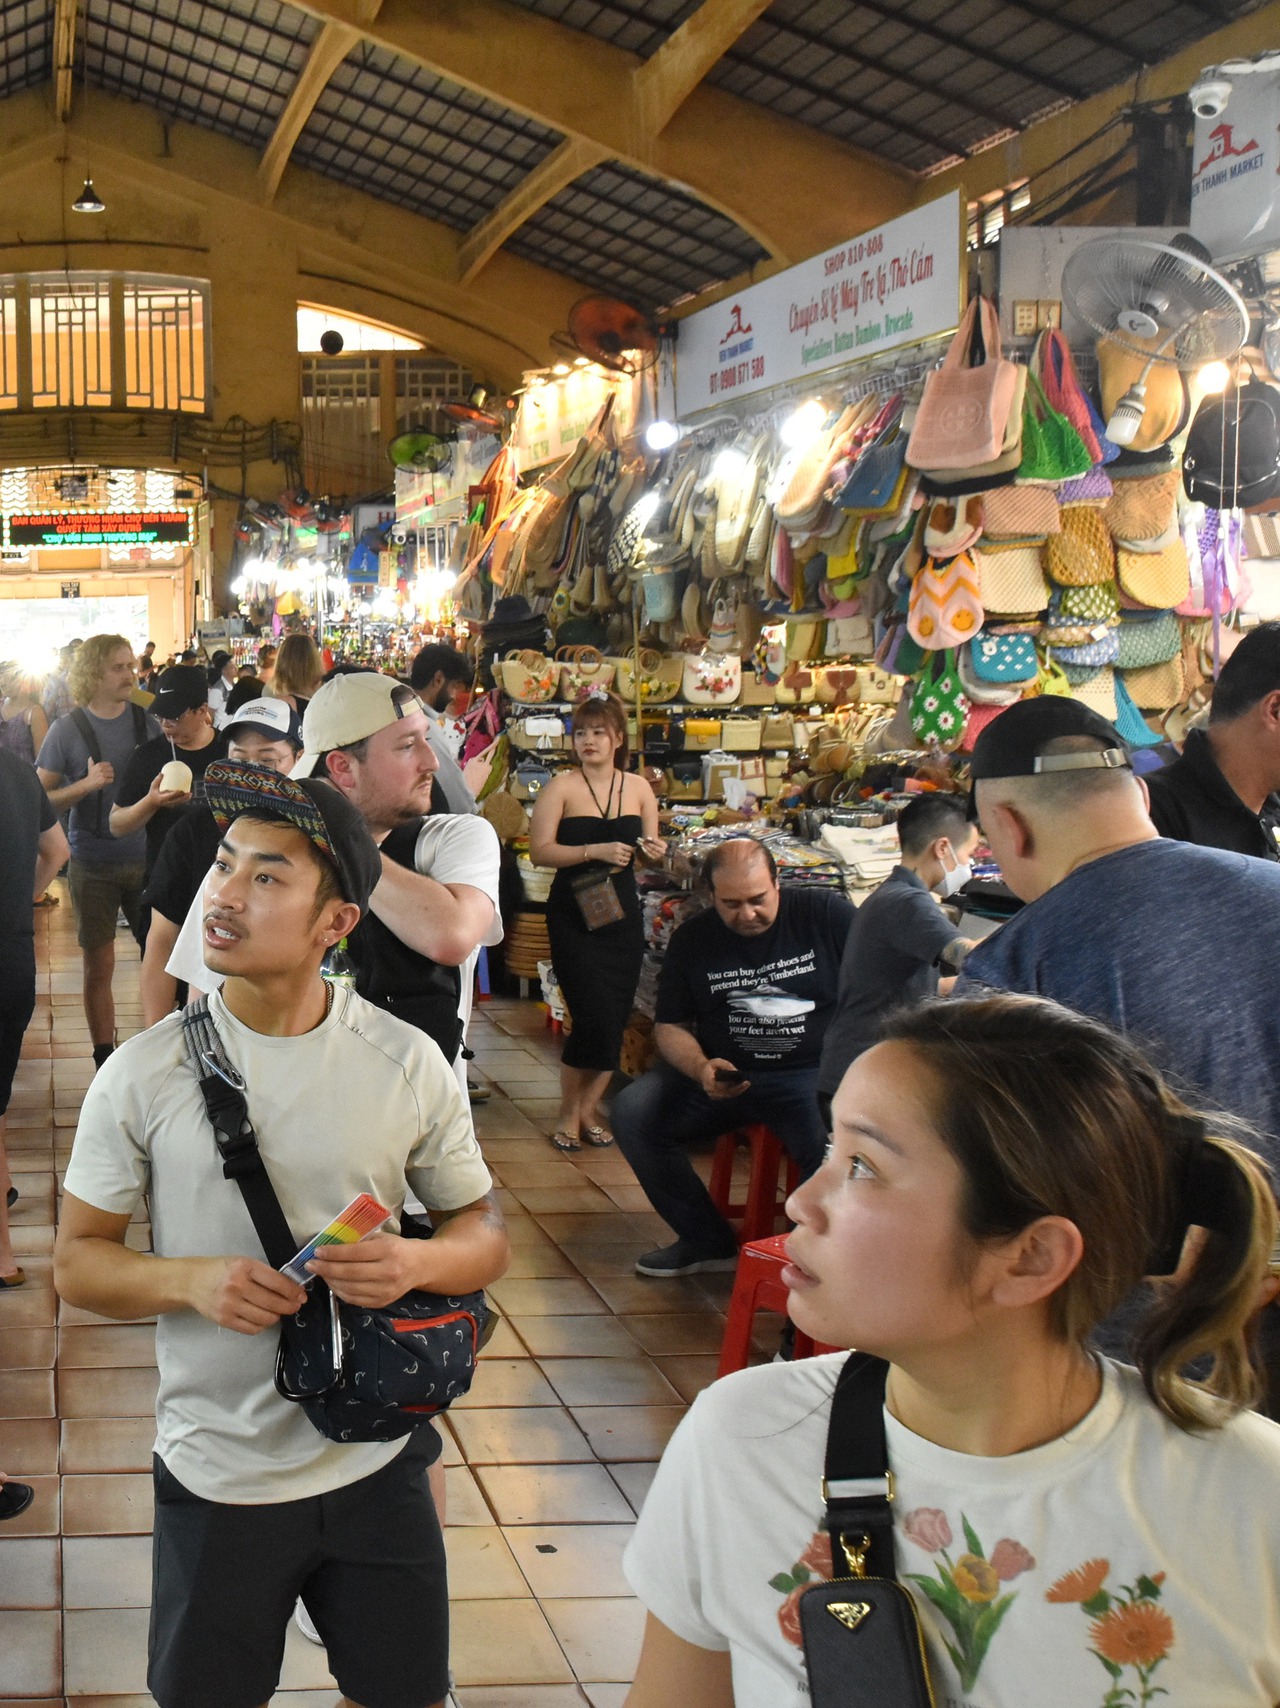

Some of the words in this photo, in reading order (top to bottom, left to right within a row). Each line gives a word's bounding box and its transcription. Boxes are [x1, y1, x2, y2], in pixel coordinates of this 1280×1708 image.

[1202, 169, 1227, 192] THANH
[1230, 153, 1264, 179] MARKET
[824, 251, 845, 277] SHOP
[861, 271, 874, 303] Tre
[11, 515, 28, 526] BAN
[707, 972, 722, 981] You
[723, 970, 738, 978] can
[739, 967, 755, 978] buy
[756, 962, 776, 977] other
[776, 956, 800, 969] shoes
[799, 948, 816, 963] and
[710, 979, 740, 994] pretend
[768, 961, 817, 982] Timberland.
[728, 1014, 741, 1024] You
[742, 1016, 757, 1024] can
[758, 1016, 775, 1025] also
[728, 1026, 747, 1035] your
[748, 1025, 764, 1035] feet
[790, 1024, 806, 1034] wet
